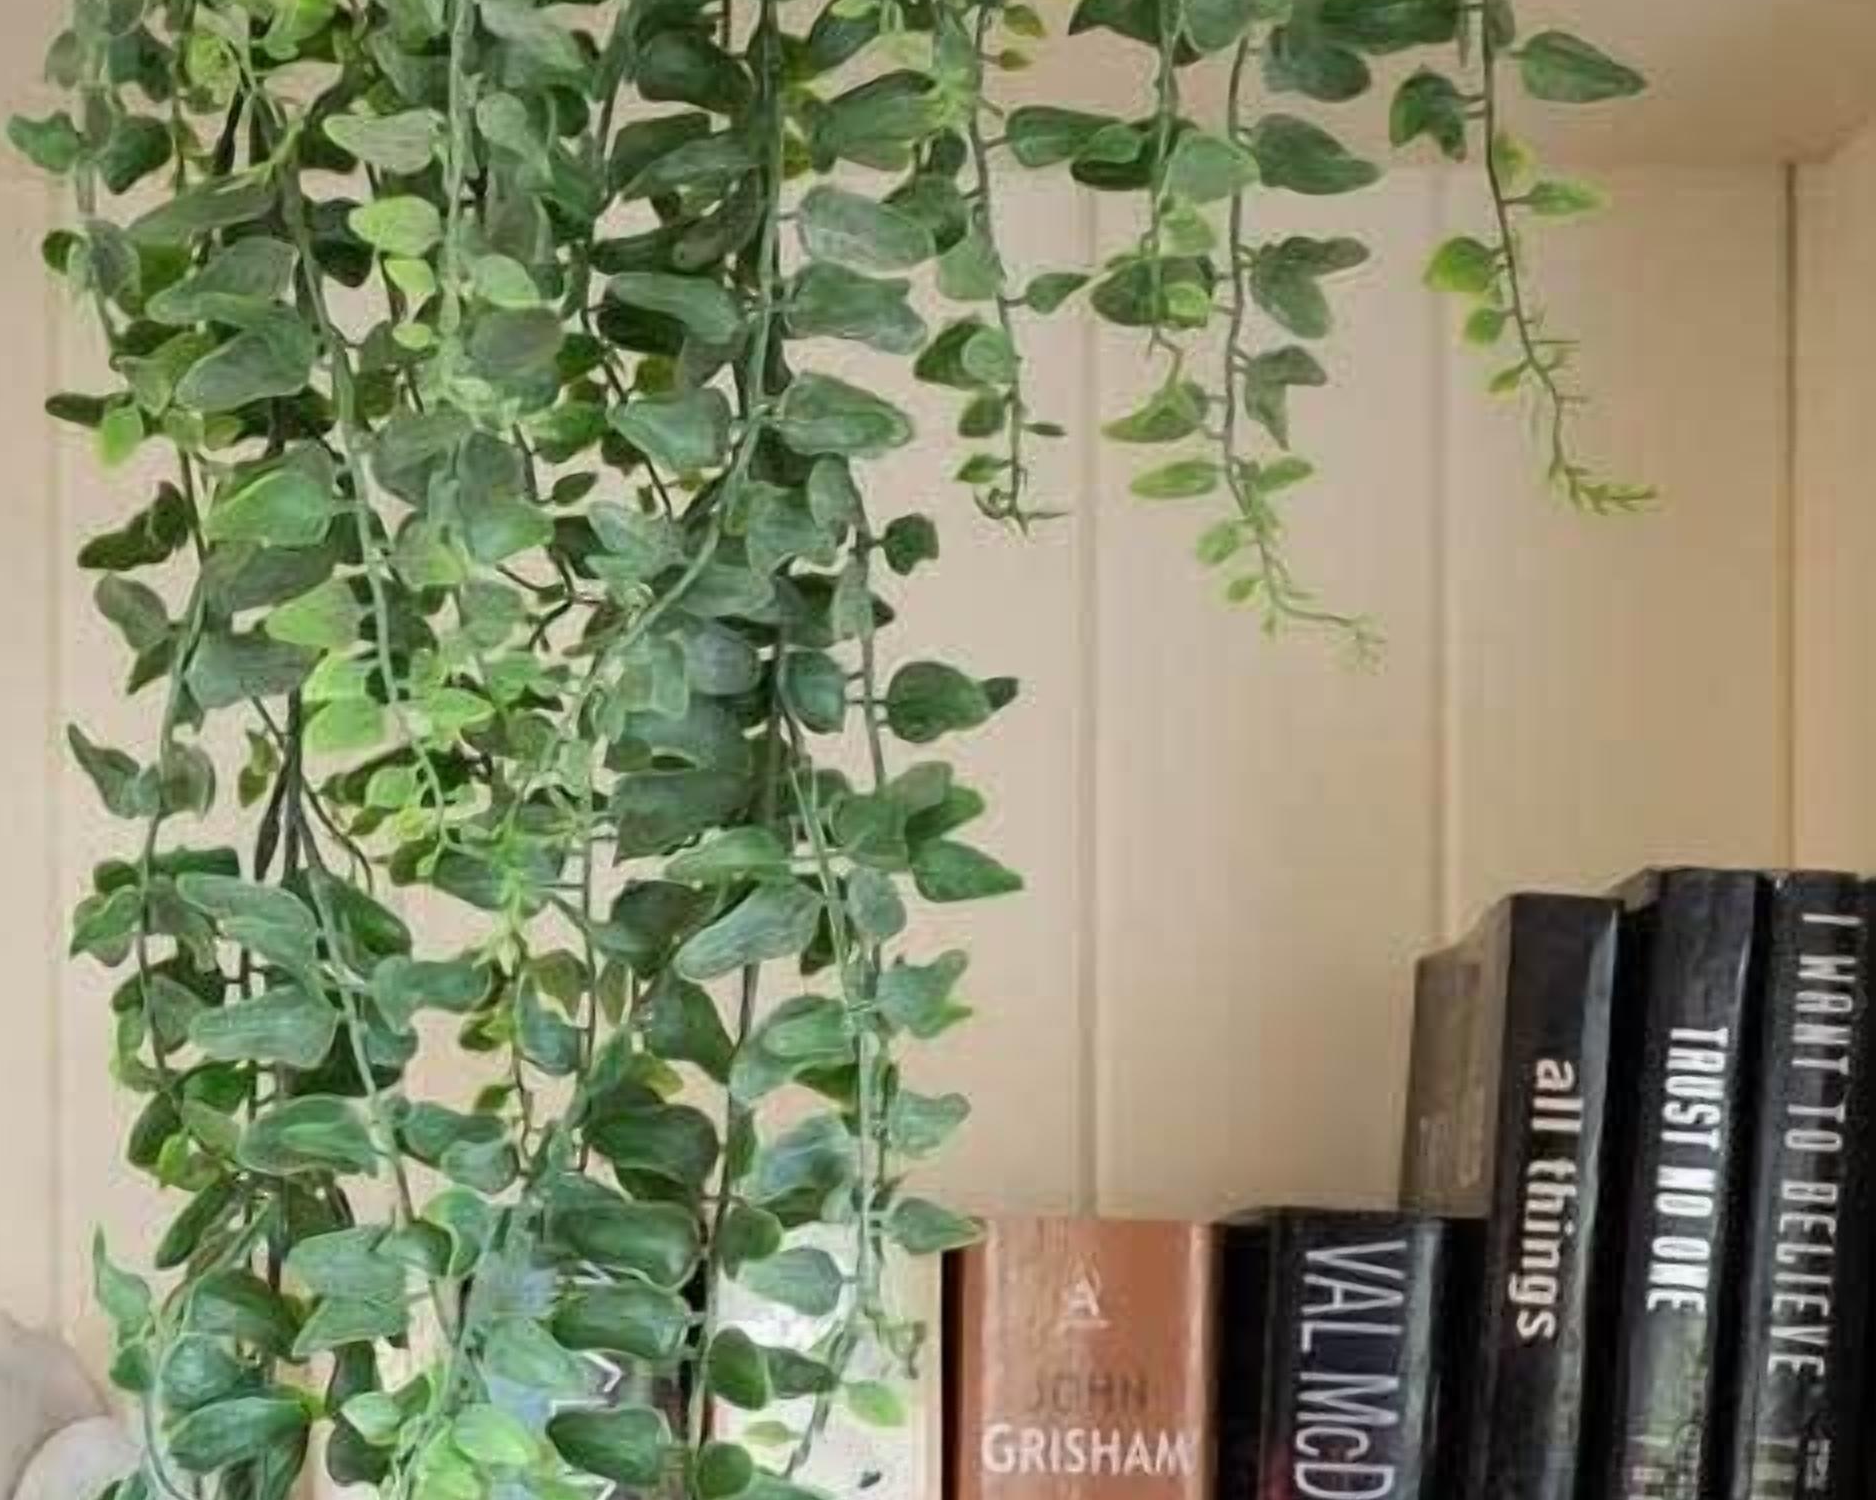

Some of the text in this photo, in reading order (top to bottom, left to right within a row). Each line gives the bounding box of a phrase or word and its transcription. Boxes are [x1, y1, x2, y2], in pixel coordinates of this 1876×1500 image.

[1791, 954, 1859, 1077] WANT
[1645, 1025, 1729, 1314] TRUST NO ONE
[1783, 1102, 1847, 1155] TO
[1506, 1056, 1585, 1343] all things
[1300, 1238, 1407, 1352] VAL
[1767, 1180, 1840, 1378] BELIEVE
[981, 1421, 1198, 1476] GRISHAM
[1026, 1371, 1150, 1413] JOHN
